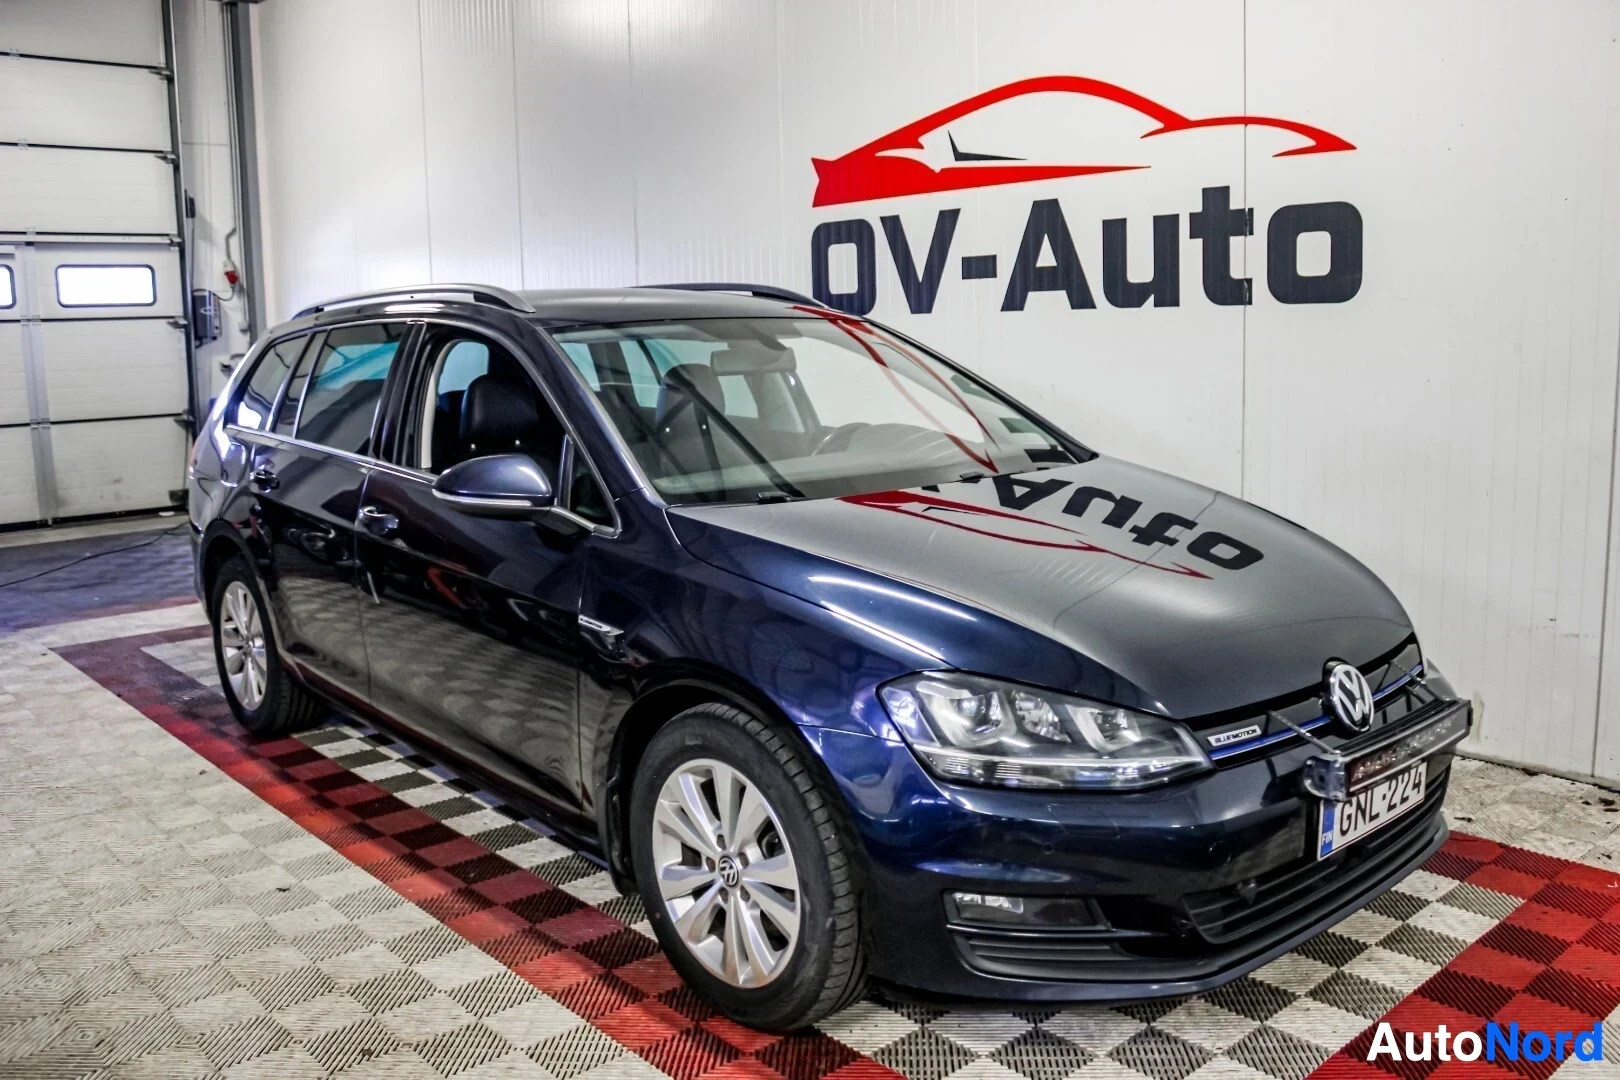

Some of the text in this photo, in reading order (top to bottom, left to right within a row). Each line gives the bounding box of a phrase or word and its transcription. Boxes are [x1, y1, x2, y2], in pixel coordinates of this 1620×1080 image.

[1214, 728, 1258, 744] BLUEMOTION
[1340, 767, 1422, 837] GNL-224
[1321, 829, 1334, 847] FIN
